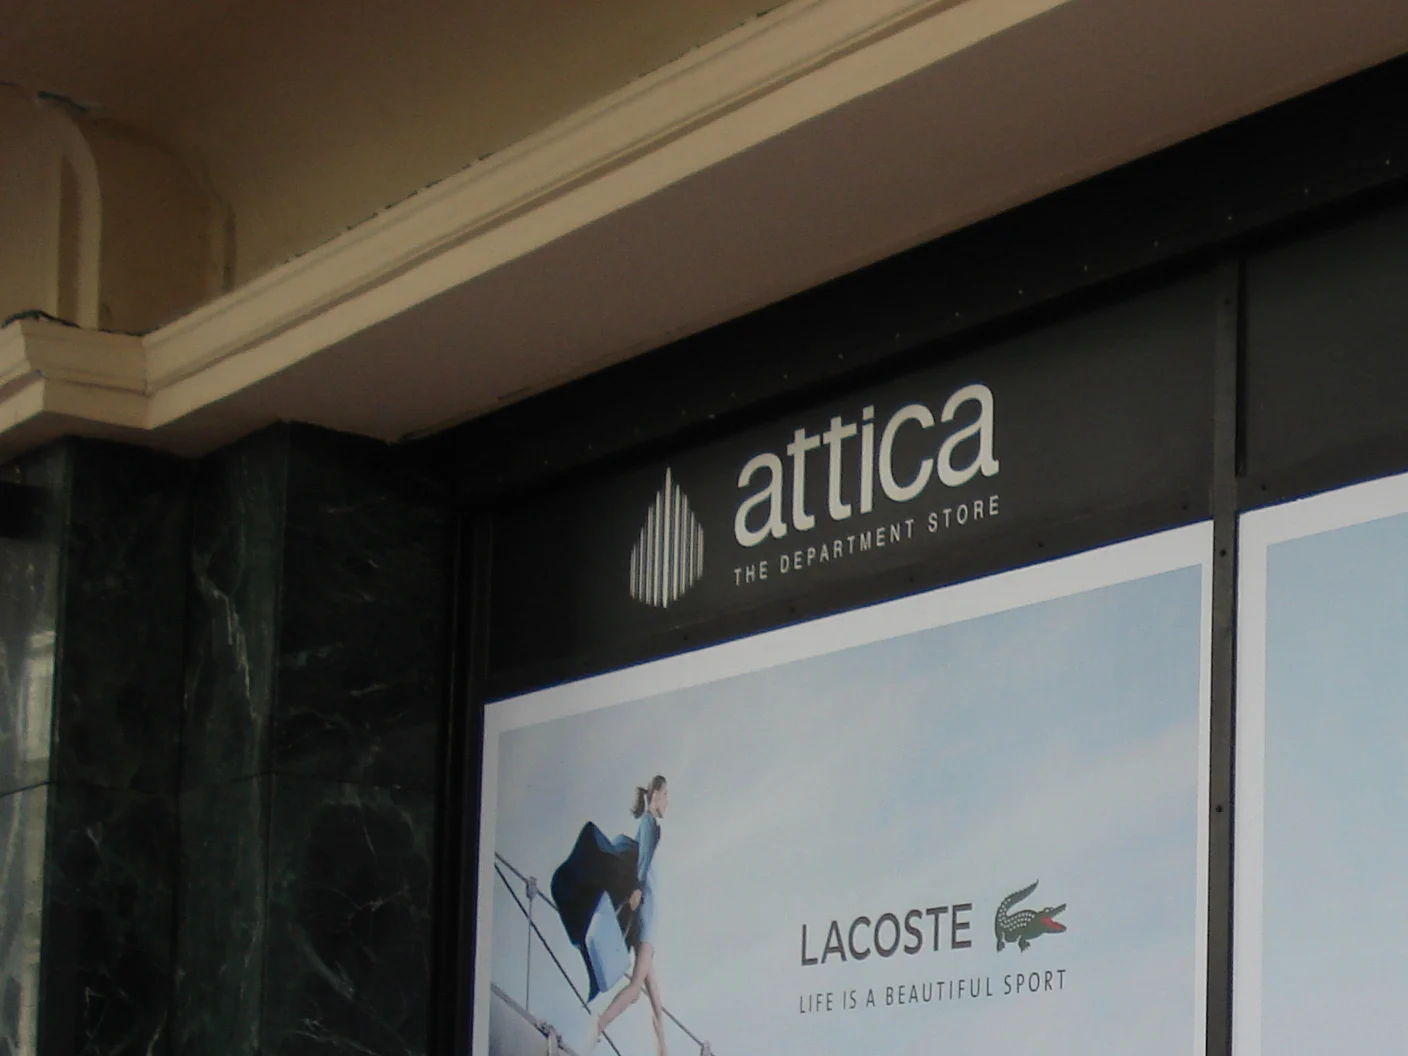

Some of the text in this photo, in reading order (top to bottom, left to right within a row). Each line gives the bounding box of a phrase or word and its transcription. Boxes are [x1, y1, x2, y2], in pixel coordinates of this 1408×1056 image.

[734, 384, 999, 547] attica
[734, 495, 999, 585] THE DEPARTMENT STORE
[801, 903, 972, 966] LACOSTE
[800, 969, 1066, 1013] LIFE IS A BEAUTIFUL SPORT
